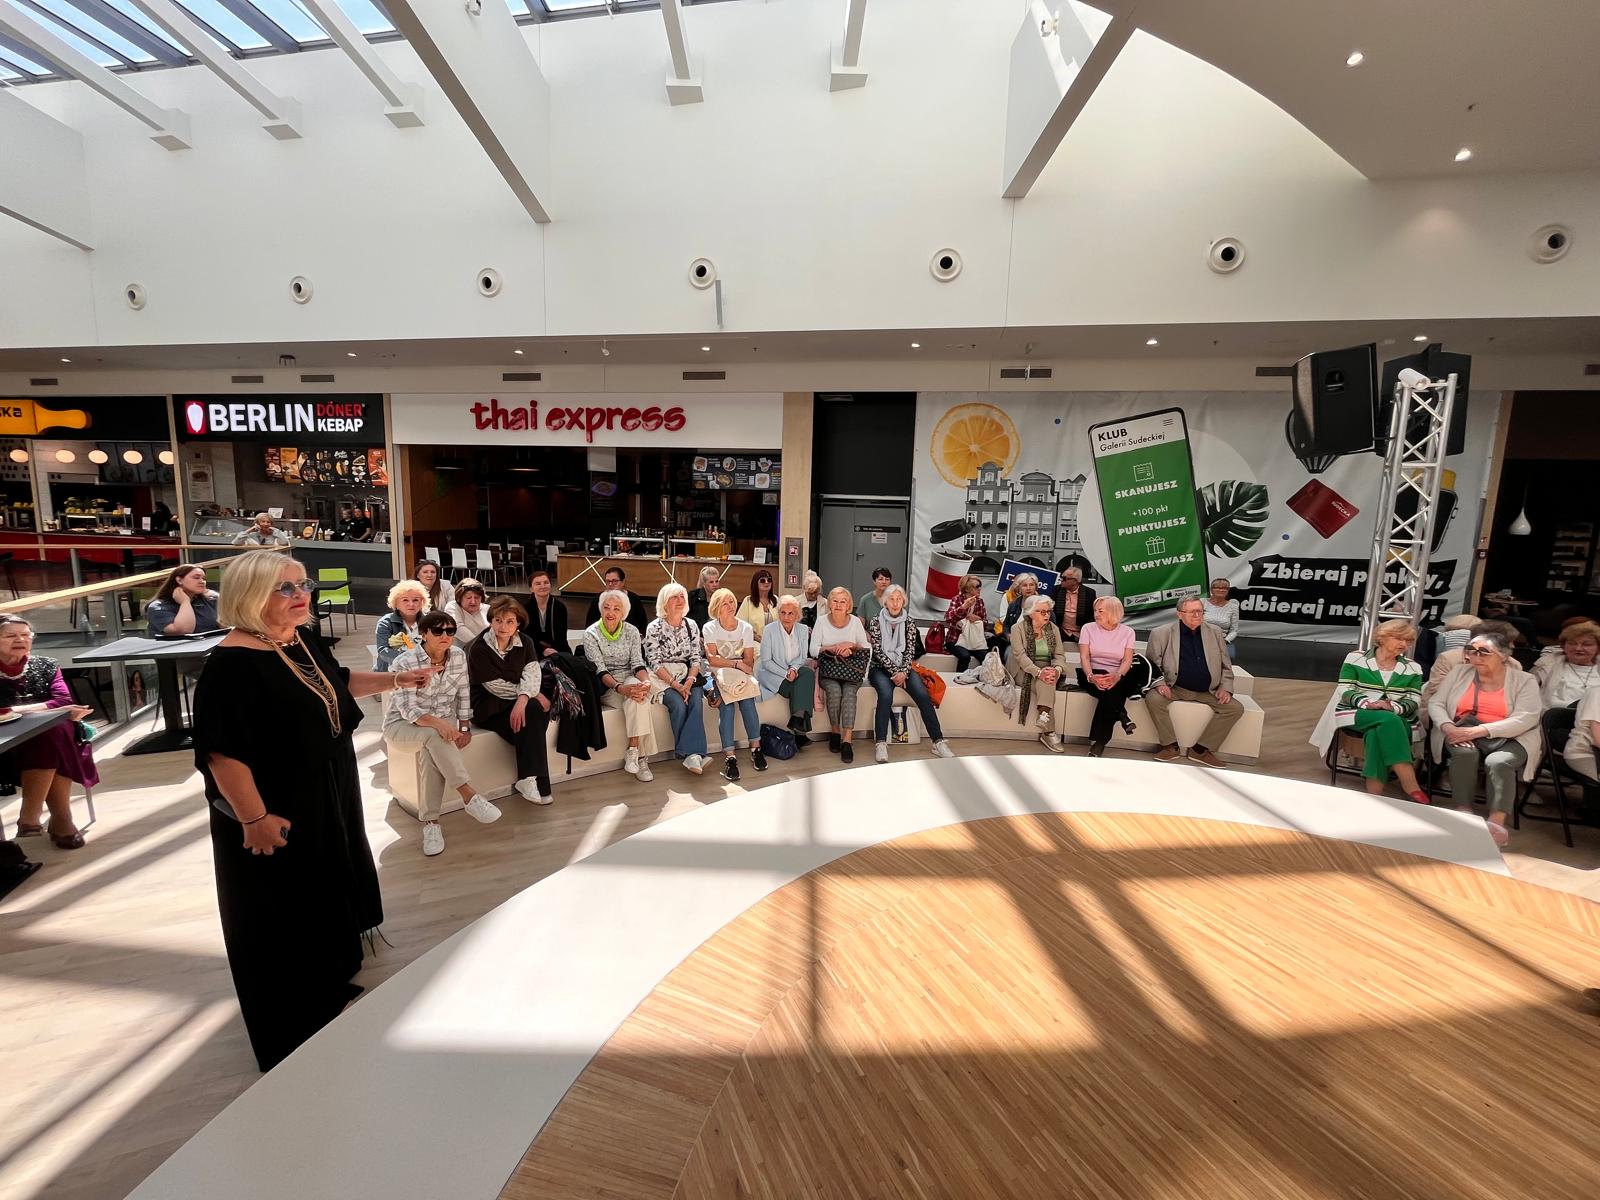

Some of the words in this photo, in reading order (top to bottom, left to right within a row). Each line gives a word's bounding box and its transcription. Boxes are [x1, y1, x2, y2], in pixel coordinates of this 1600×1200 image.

[208, 403, 315, 432] BERLIN
[316, 401, 364, 417] DÖNER
[317, 418, 364, 432] KEBAP
[469, 398, 538, 430] thai
[545, 406, 687, 443] express
[1098, 428, 1128, 441] KLUB
[1100, 440, 1127, 452] Galerii
[1128, 432, 1165, 446] Sudeckiej
[1114, 480, 1178, 499] SKANUJESZ
[1131, 507, 1154, 516] +100
[1155, 504, 1169, 516] pkt
[1117, 516, 1187, 536] PUNKTUJESZ
[1121, 553, 1195, 573] WYGRYWASZ
[1260, 562, 1349, 587] Zbieraj
[1240, 594, 1325, 619] dbieraj
